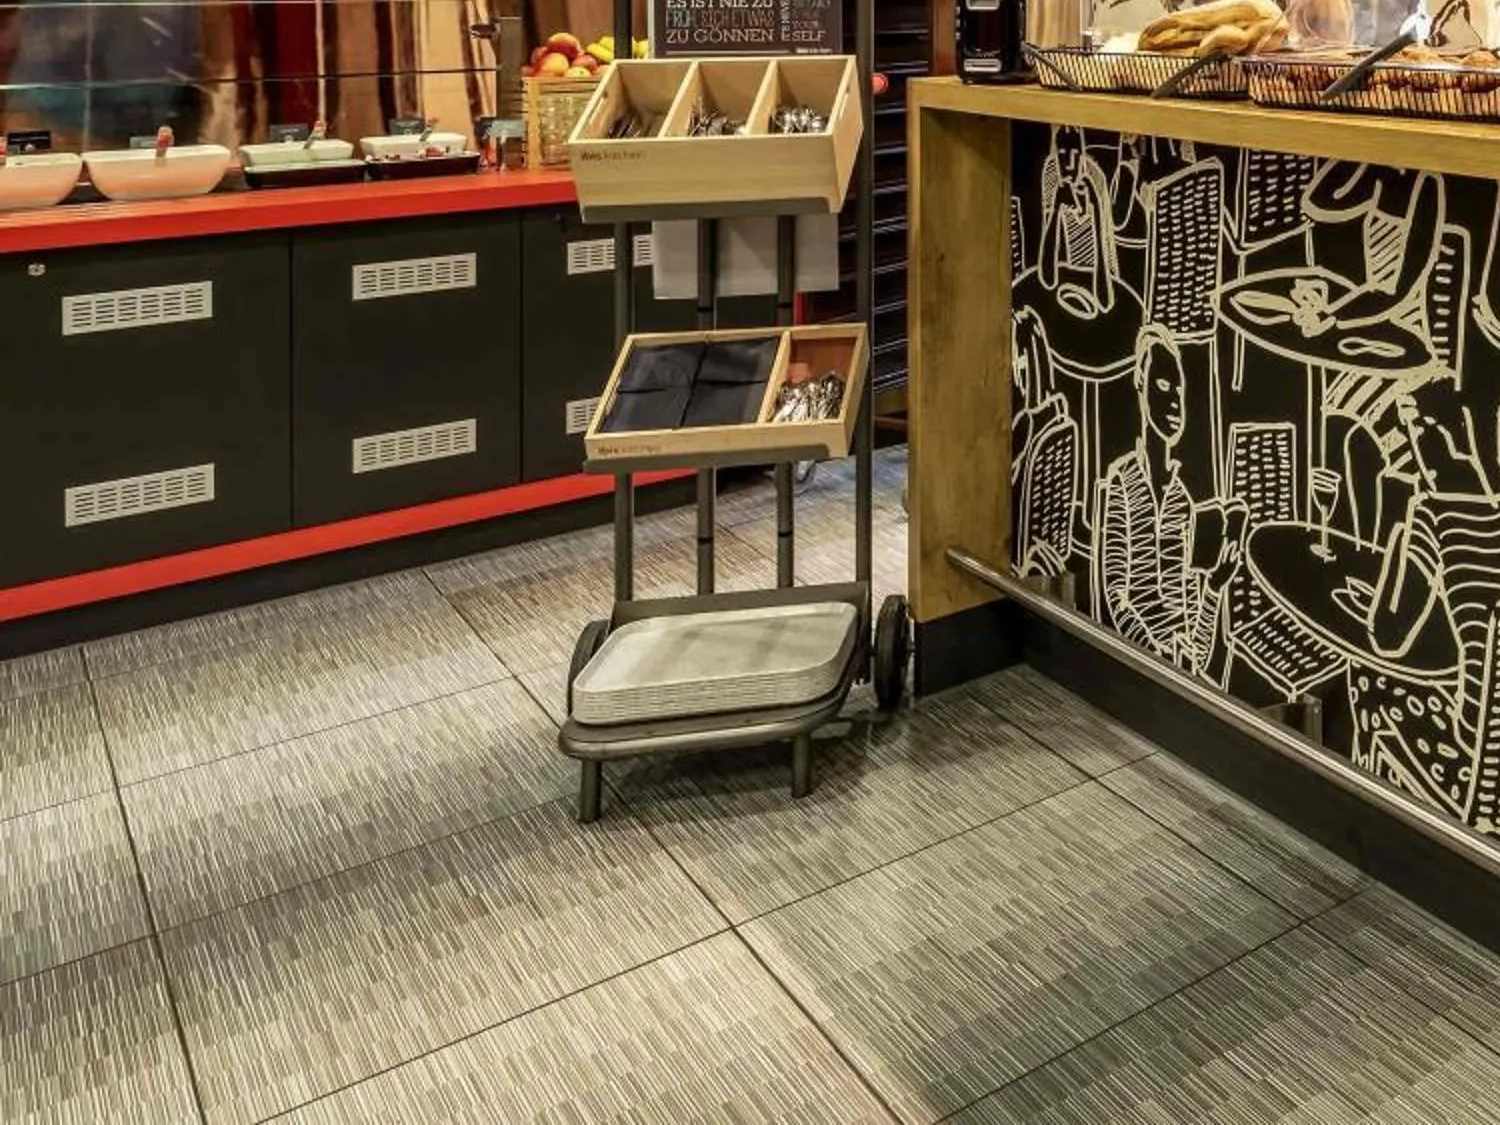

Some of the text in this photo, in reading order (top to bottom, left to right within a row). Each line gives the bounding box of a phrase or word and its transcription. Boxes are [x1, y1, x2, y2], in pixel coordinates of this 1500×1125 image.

[665, 26, 775, 43] ZU GÖNNEN
[791, 30, 826, 42] SELF
